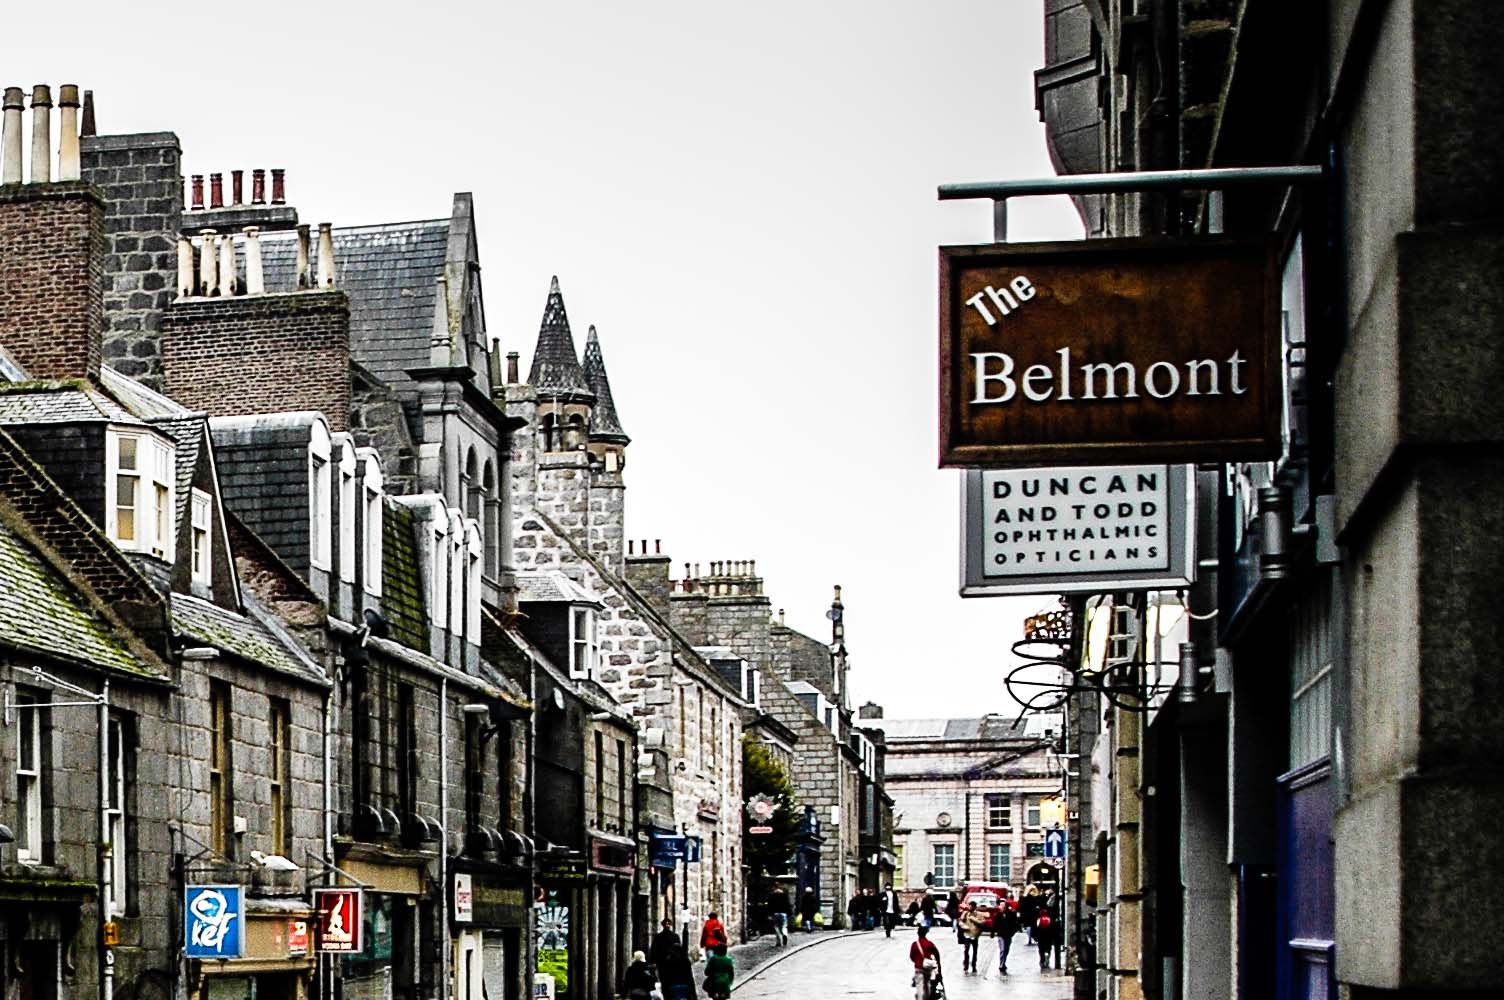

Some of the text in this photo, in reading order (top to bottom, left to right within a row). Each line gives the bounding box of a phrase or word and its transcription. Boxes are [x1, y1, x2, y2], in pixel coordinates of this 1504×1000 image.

[965, 275, 1036, 326] The
[969, 346, 1248, 404] Belmont
[994, 473, 1157, 499] DUNCAN
[994, 501, 1157, 524] AND TODD
[994, 524, 1157, 544] OPHTHALMIC
[994, 546, 1158, 565] OPTICIANS
